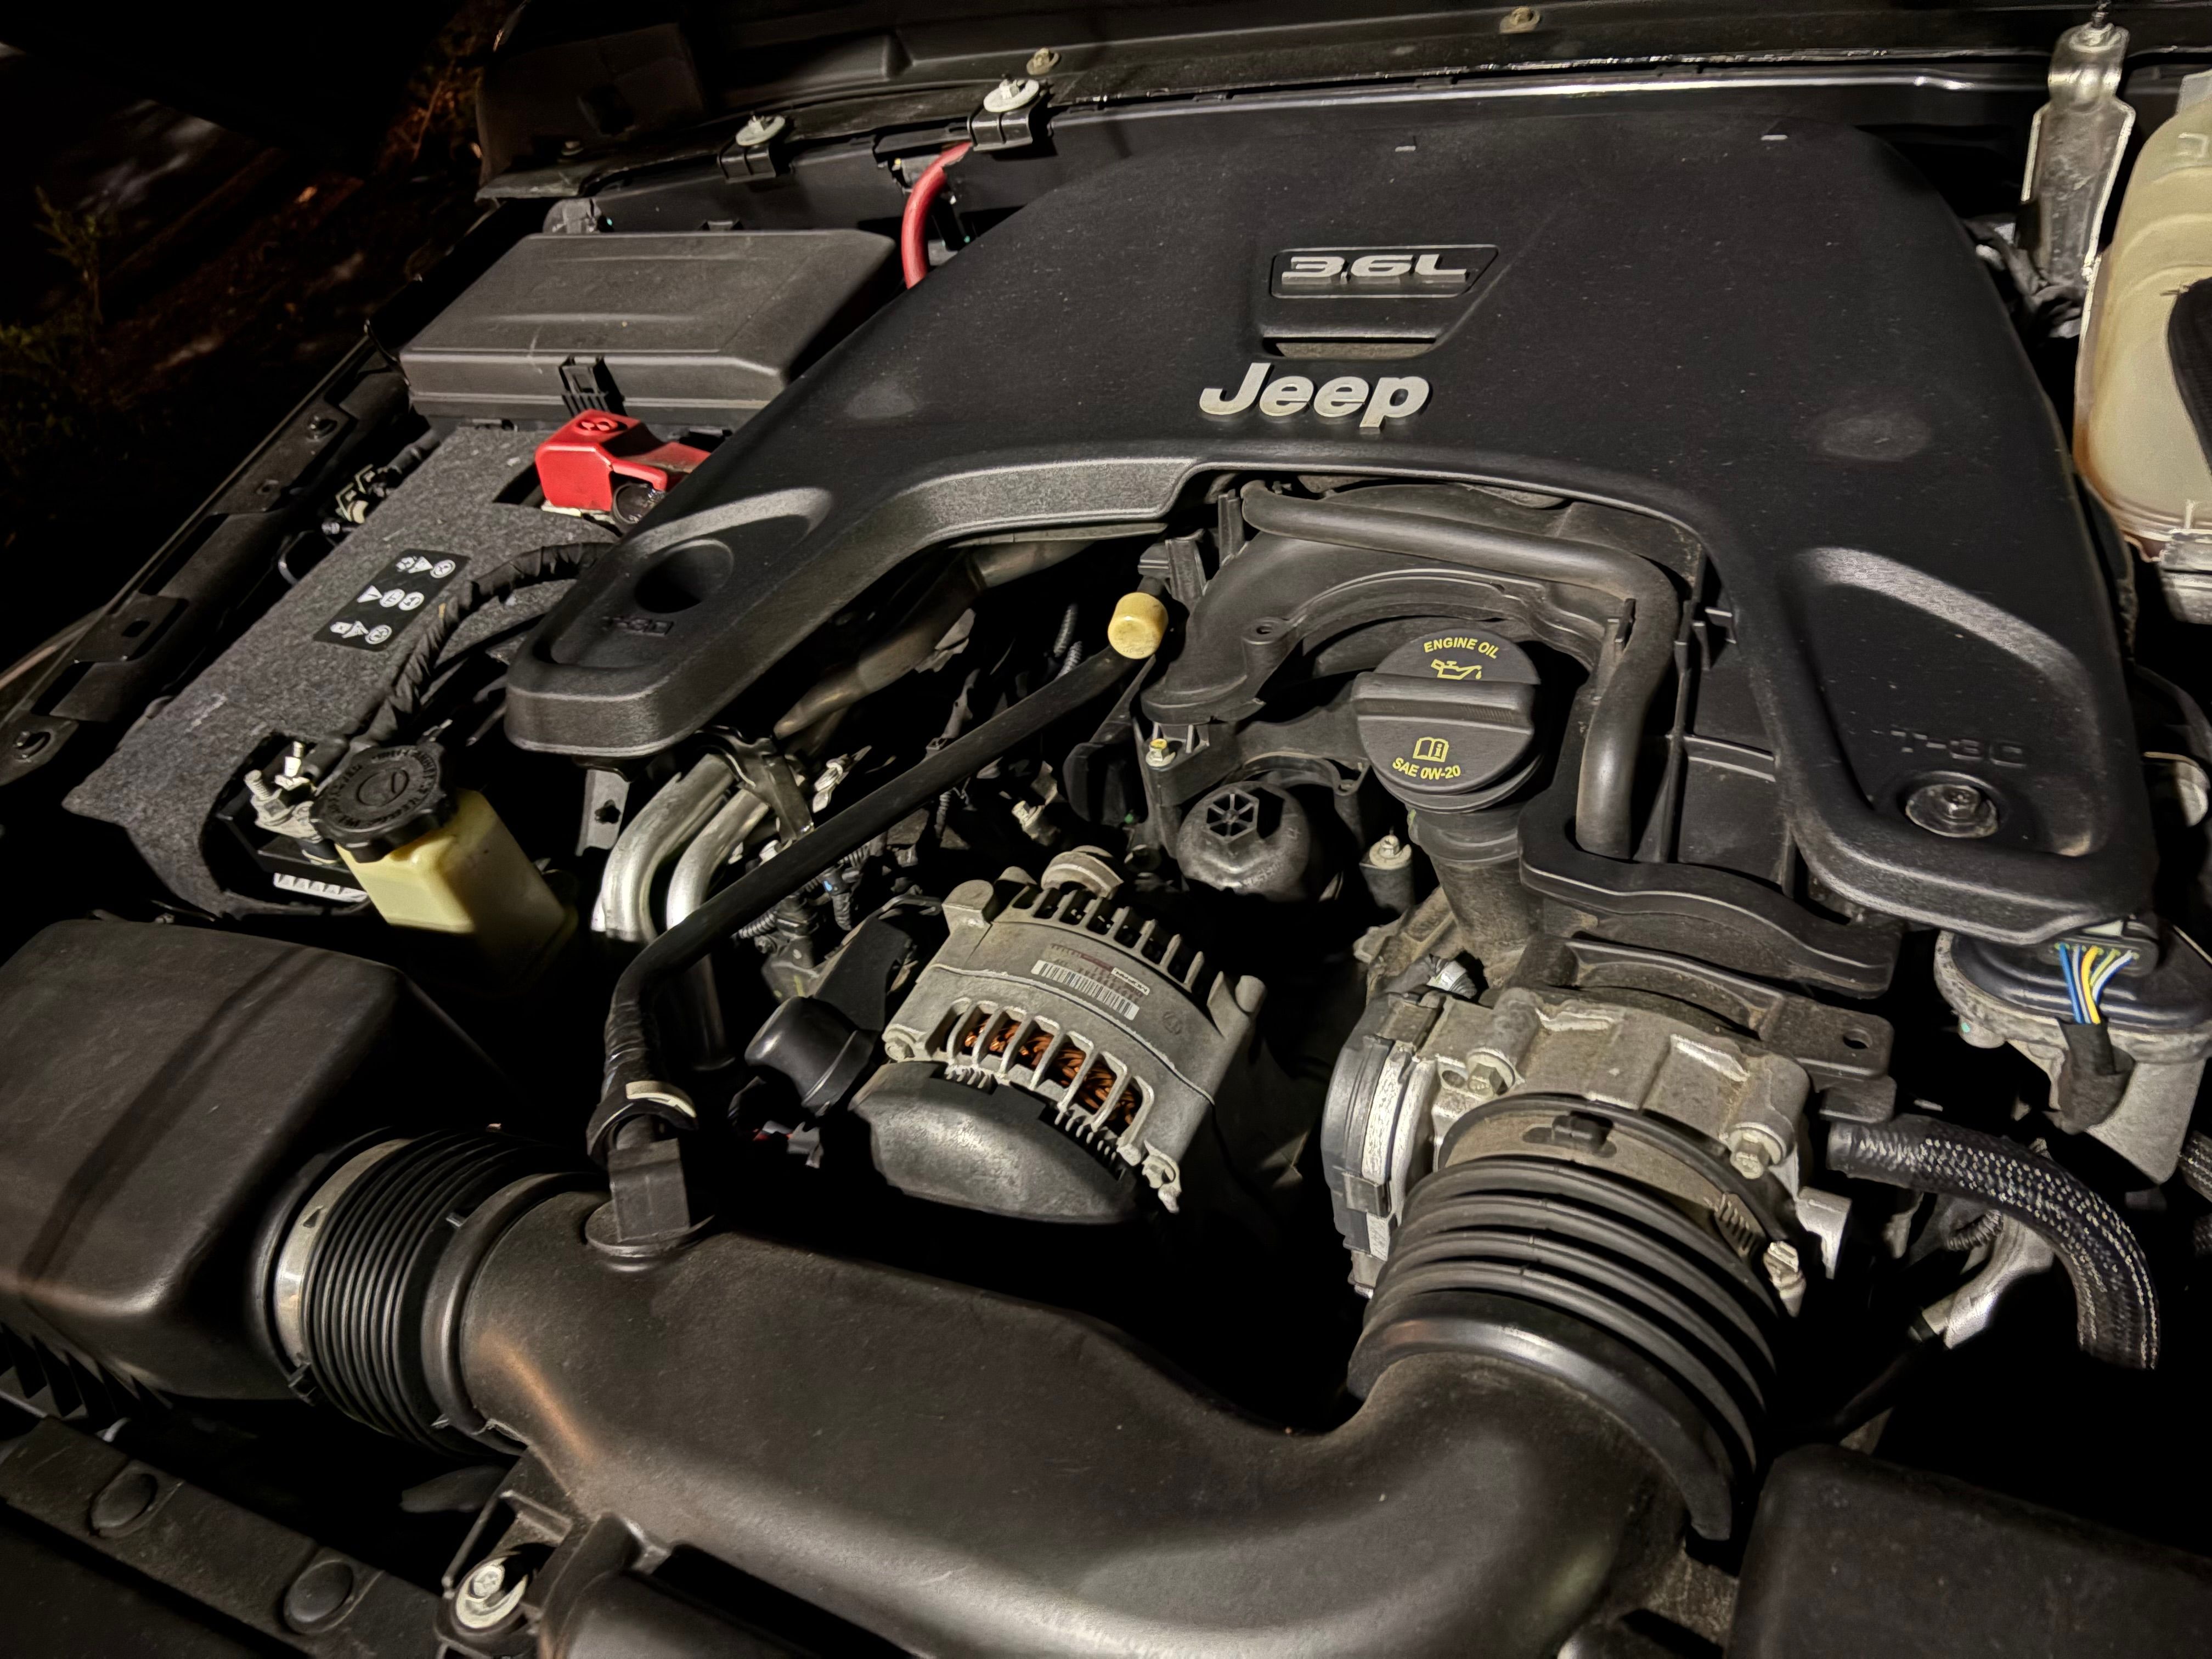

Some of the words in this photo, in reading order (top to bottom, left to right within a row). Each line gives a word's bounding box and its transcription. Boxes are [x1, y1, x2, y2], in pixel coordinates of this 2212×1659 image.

[1282, 253, 1468, 284] 3.6L
[1199, 363, 1430, 428] Jeep
[1424, 637, 1478, 653] ENGINE
[1478, 641, 1499, 659] OIL
[1392, 757, 1420, 777] SAE
[1420, 765, 1461, 780] 0W-20
